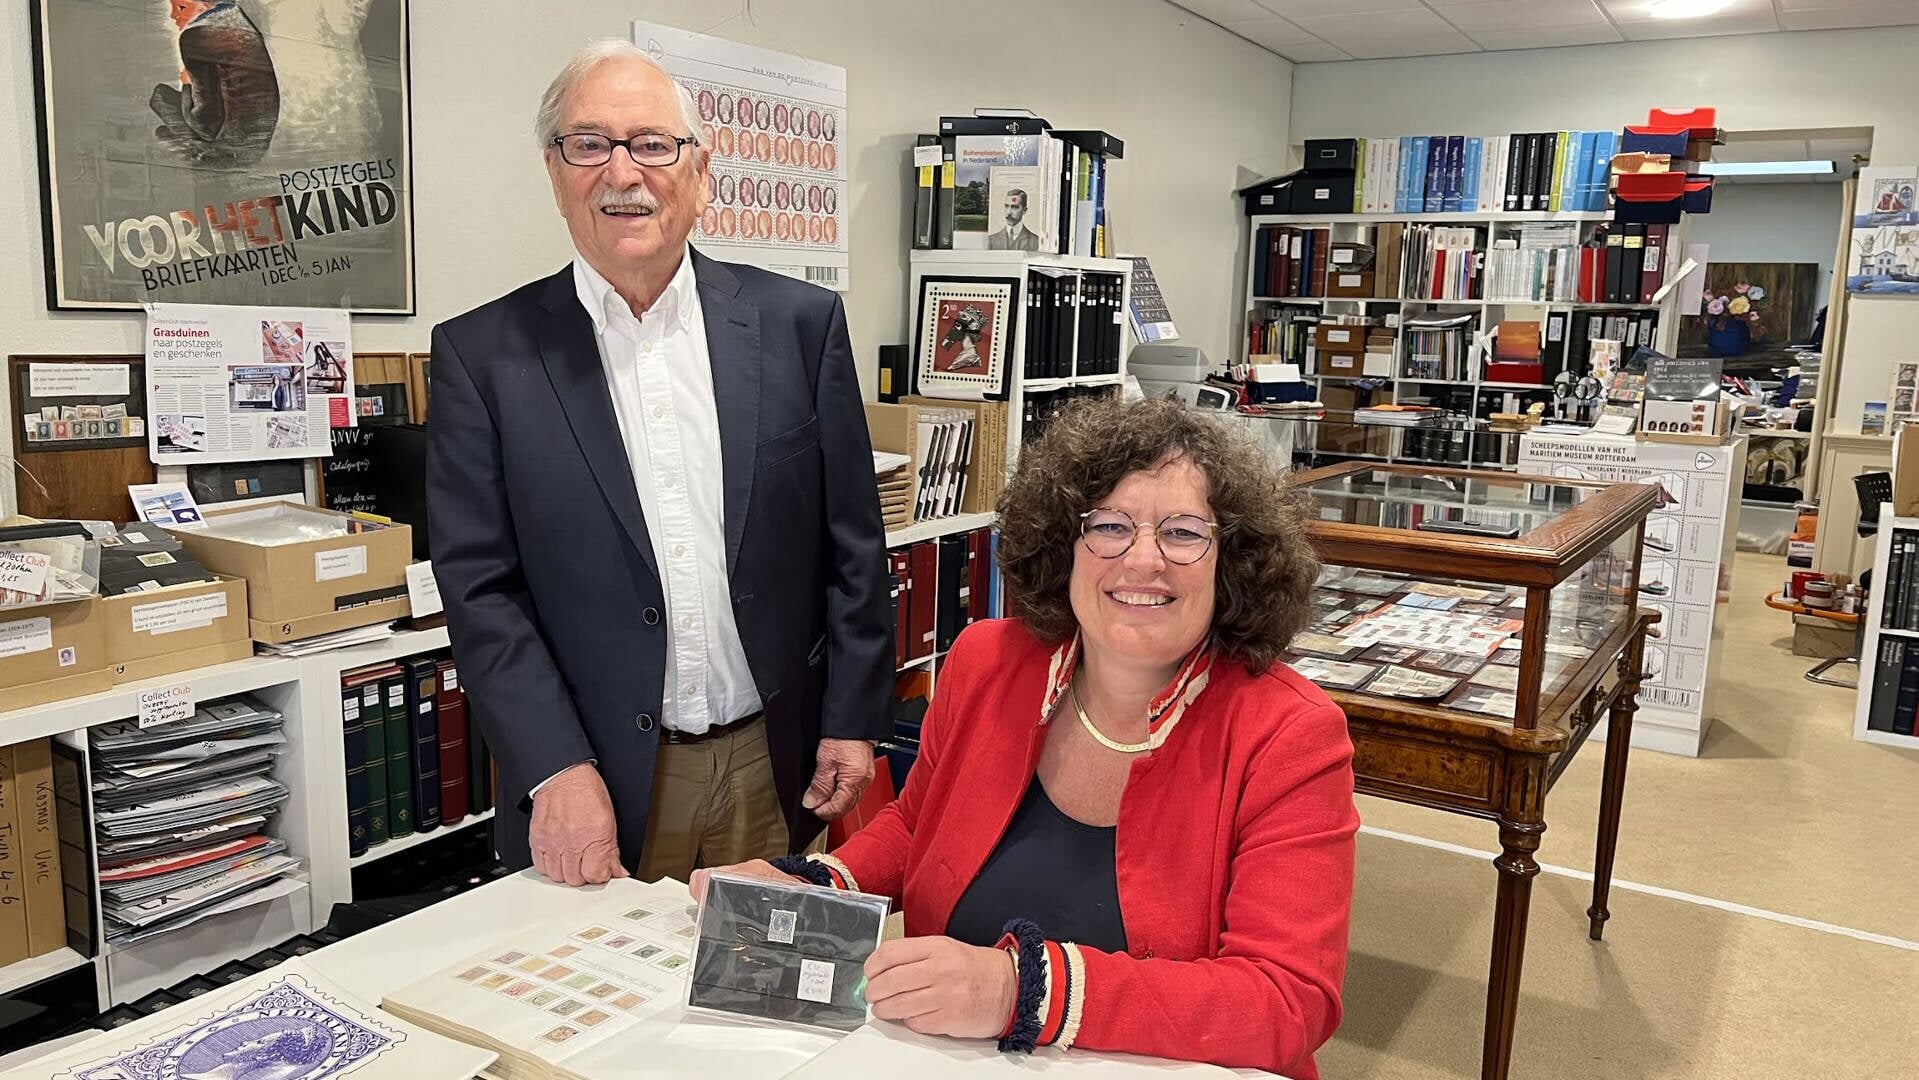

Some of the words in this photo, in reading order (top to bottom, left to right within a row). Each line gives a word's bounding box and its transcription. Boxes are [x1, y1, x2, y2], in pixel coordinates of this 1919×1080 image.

[280, 159, 396, 193] POSTZEGELS
[84, 210, 210, 273] VOOR
[204, 196, 286, 254] HET
[283, 182, 397, 240] KIND
[141, 243, 298, 291] BRIEFKAARTEN
[270, 265, 298, 284] DEC
[312, 261, 322, 275] 5
[153, 327, 210, 338] Grasduinen
[153, 339, 174, 348] naar
[176, 338, 223, 351] postzegels
[153, 350, 166, 358] en
[168, 349, 222, 360] geschenken
[1529, 450, 1562, 459] MARITIEM
[1564, 452, 1593, 460] MUSEUM
[1594, 454, 1637, 464] ROTTERDAM
[1530, 442, 1595, 453] SCHEEPSMODELLEN
[1597, 445, 1611, 454] VAN
[1613, 446, 1626, 455] HET
[0, 550, 24, 562] ollect
[25, 555, 46, 567] Club
[141, 690, 171, 703] Collect
[172, 687, 191, 697] Club
[36, 781, 53, 833] Kosmos
[258, 1009, 348, 1058] NEDERLAND
